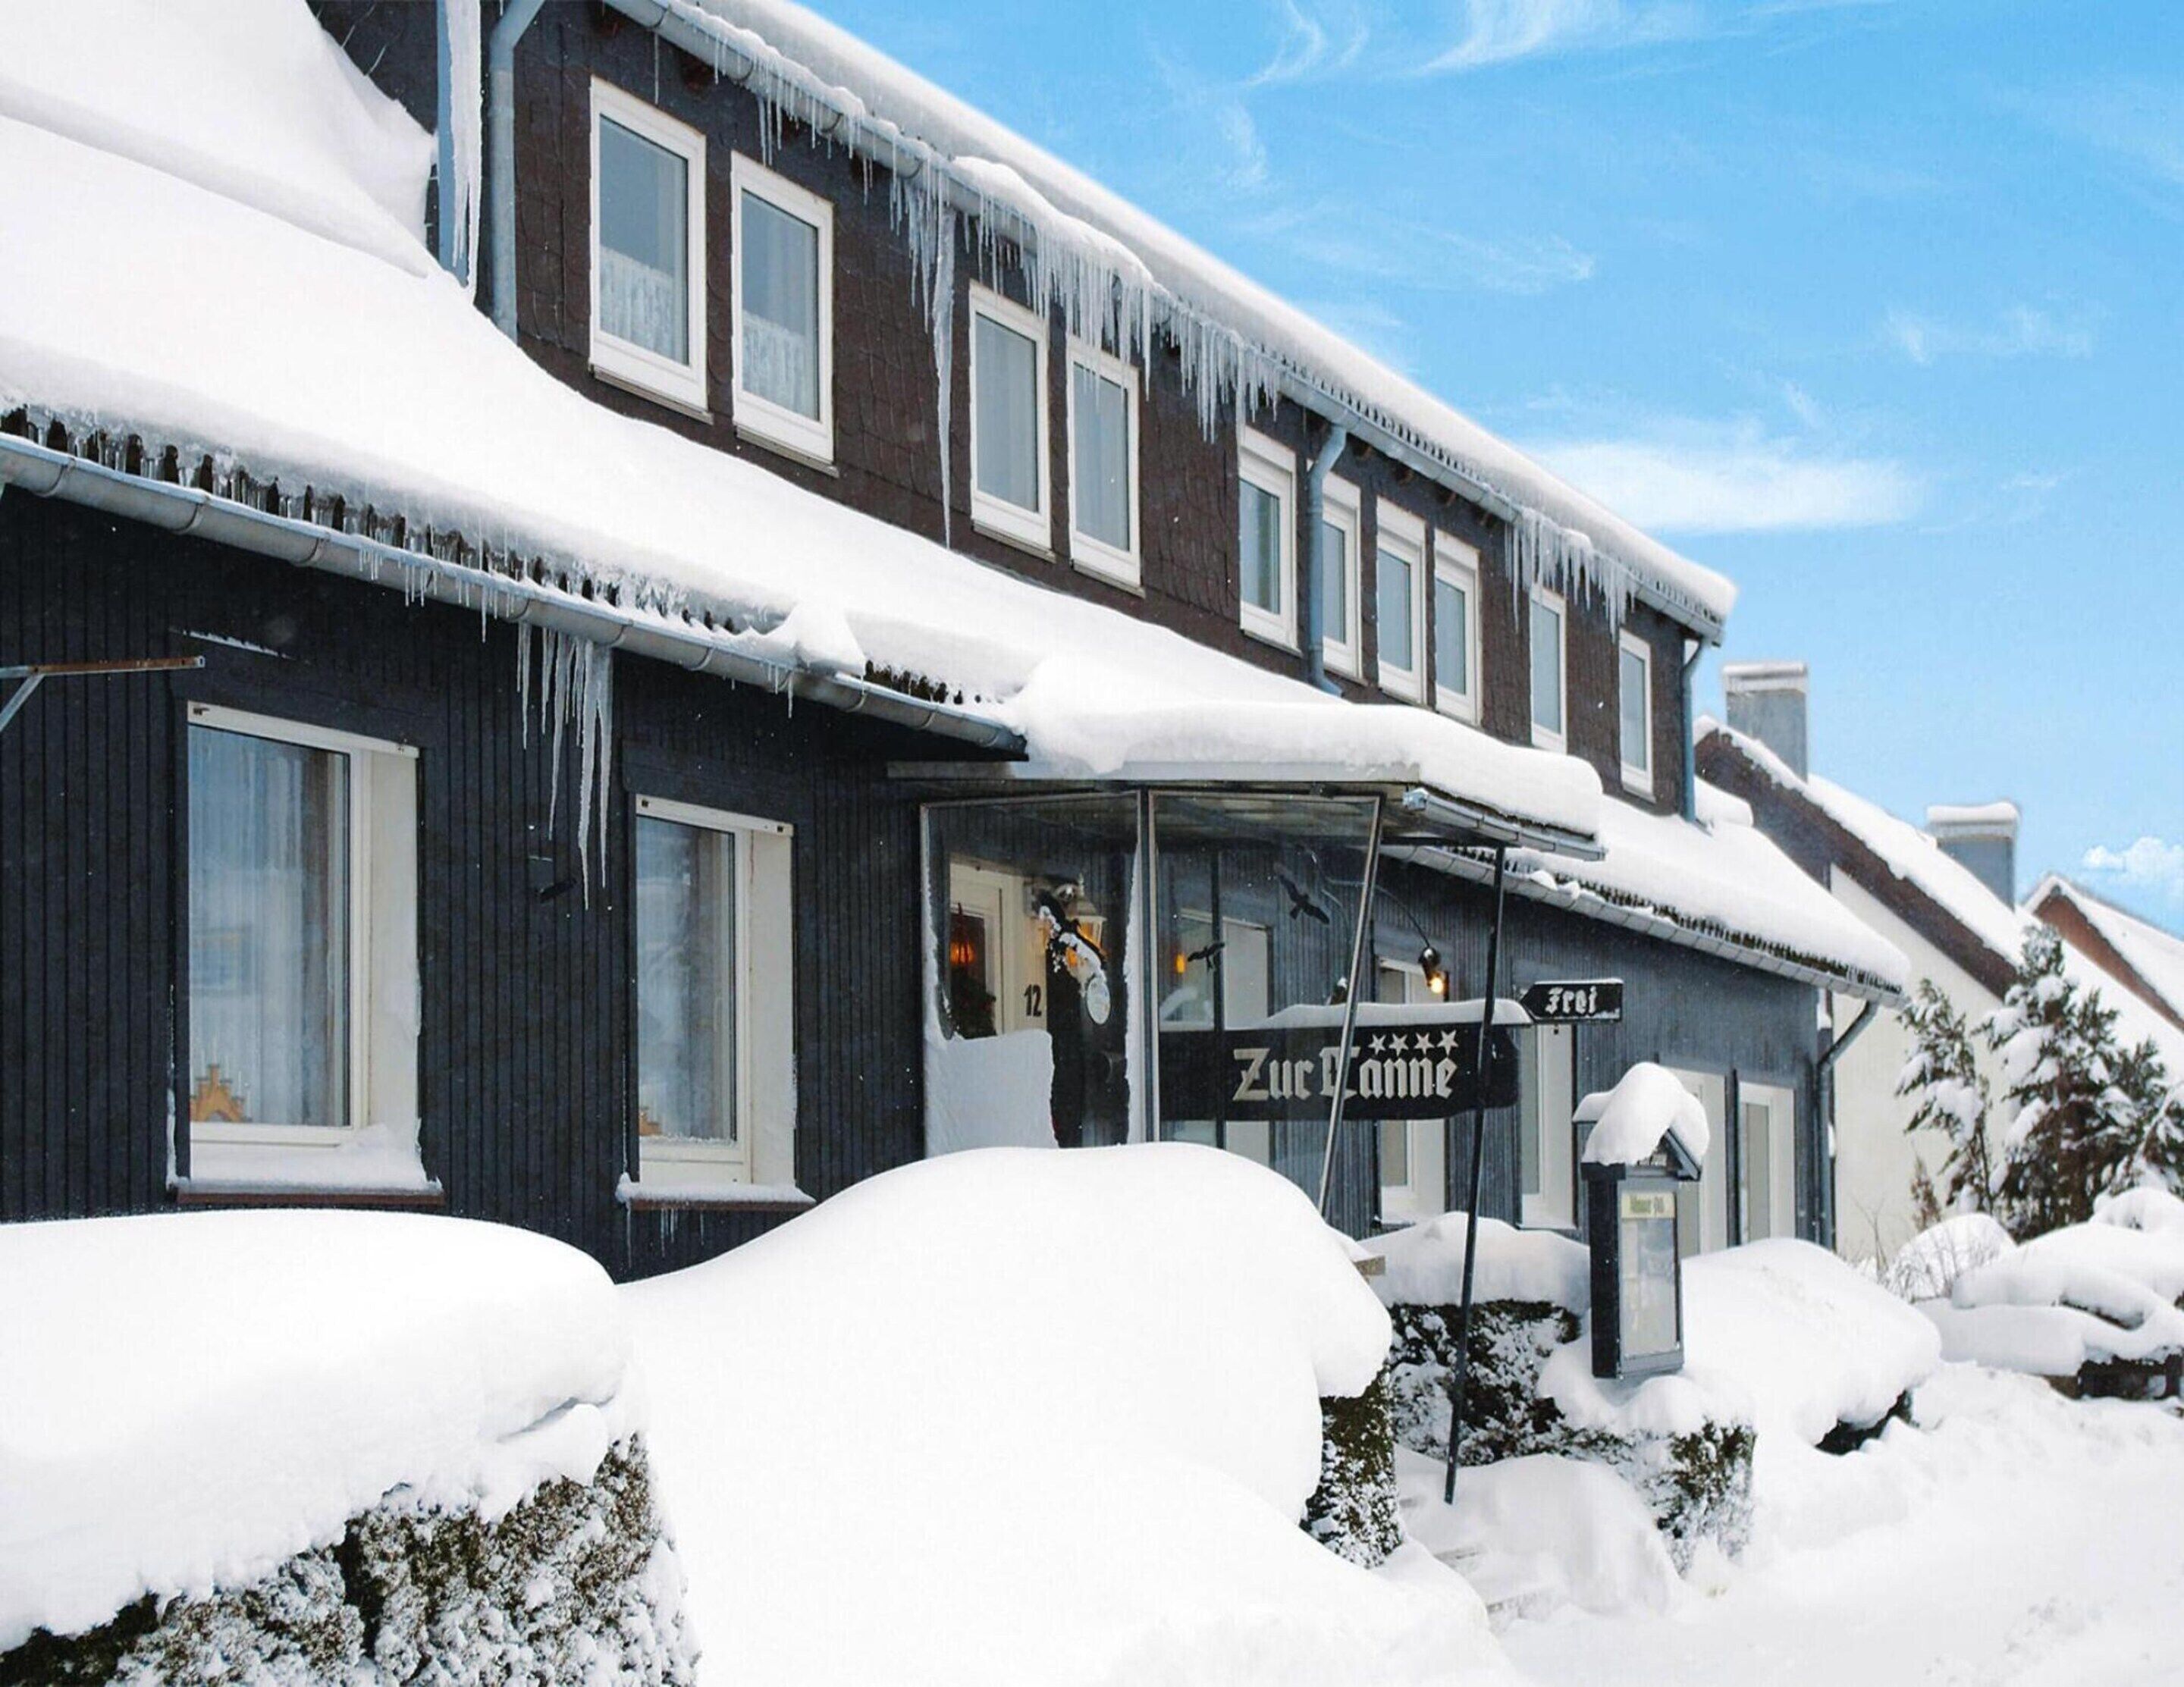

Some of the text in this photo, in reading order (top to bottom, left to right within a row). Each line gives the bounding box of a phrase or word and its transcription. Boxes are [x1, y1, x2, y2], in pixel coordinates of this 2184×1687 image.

[1024, 984, 1042, 1016] 12
[1545, 986, 1598, 1014] Frei
[1232, 1048, 1314, 1101] Zur
